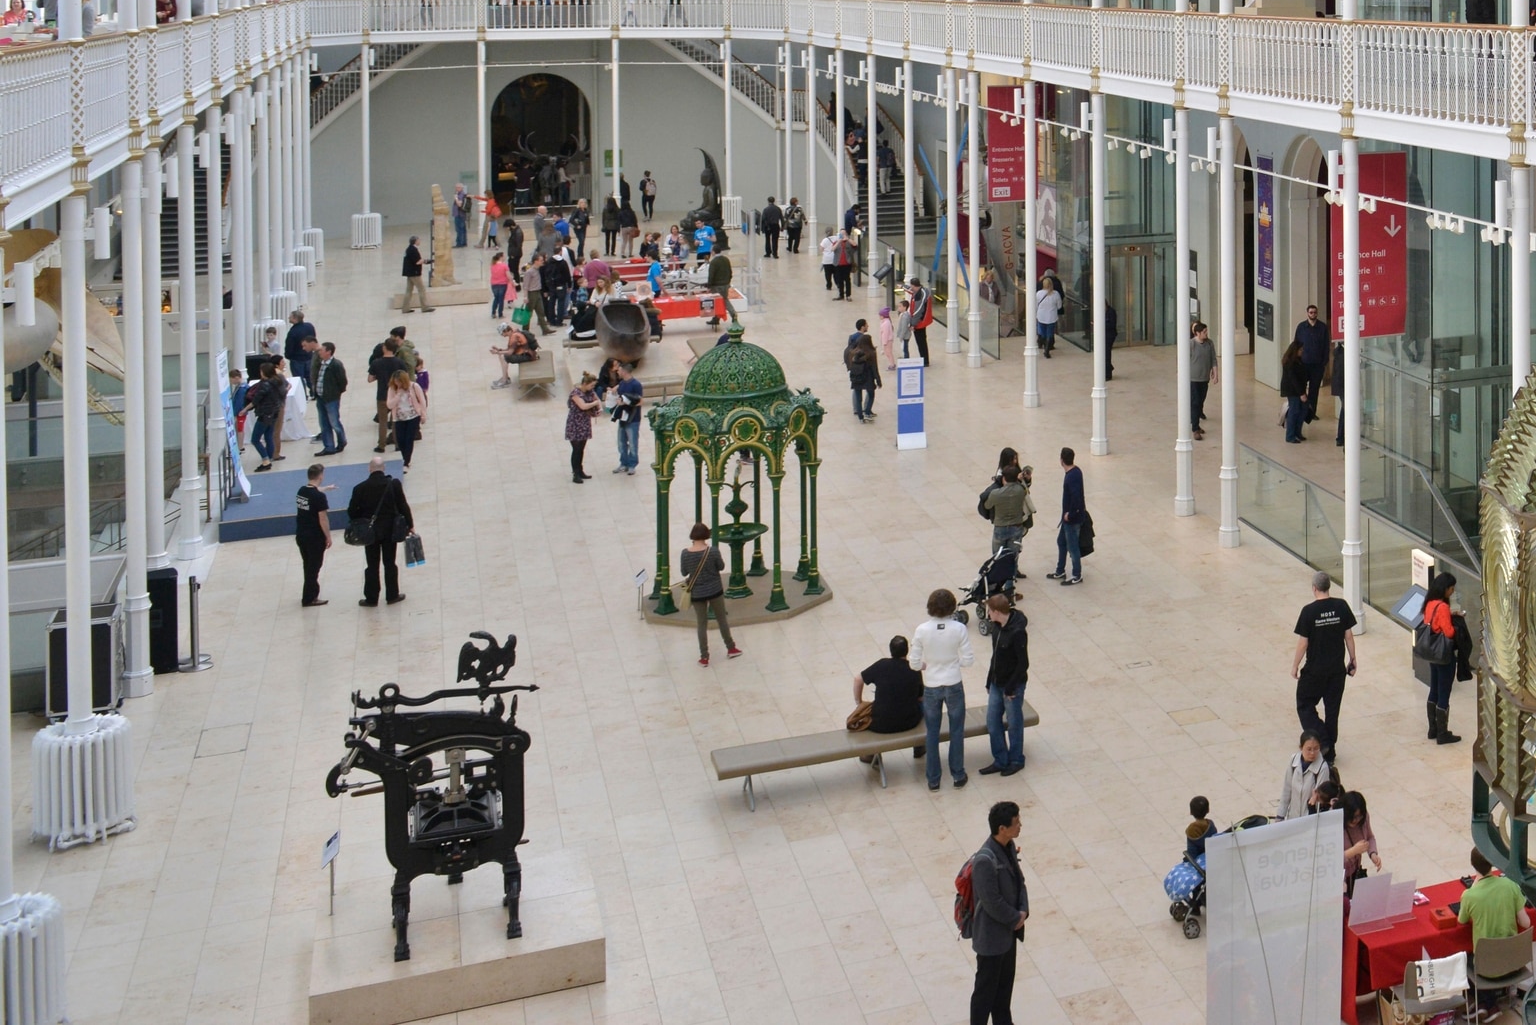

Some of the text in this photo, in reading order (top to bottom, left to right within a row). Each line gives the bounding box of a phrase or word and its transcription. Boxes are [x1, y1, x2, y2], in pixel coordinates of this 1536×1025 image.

[994, 188, 1009, 196] Exit
[1002, 226, 1014, 270] G-ACVA
[1371, 249, 1386, 258] Hall
